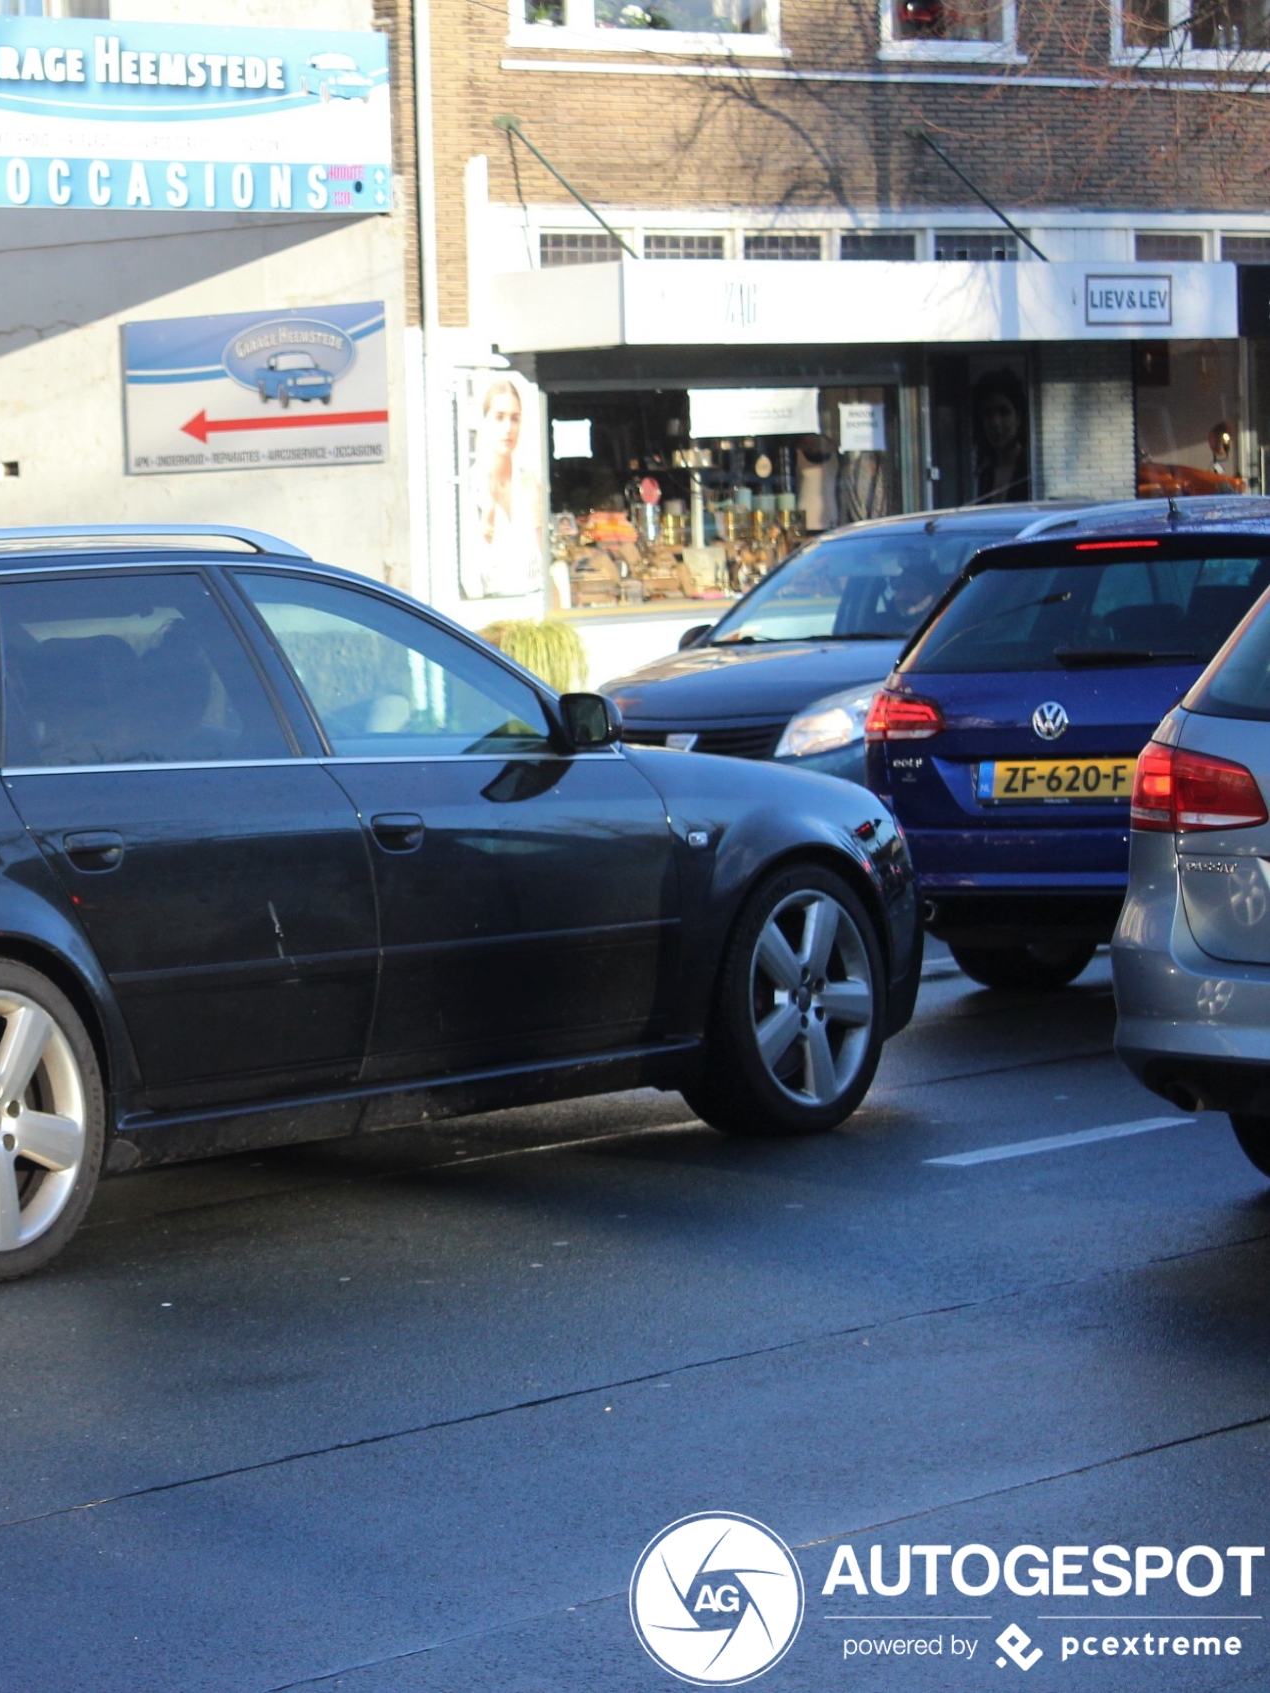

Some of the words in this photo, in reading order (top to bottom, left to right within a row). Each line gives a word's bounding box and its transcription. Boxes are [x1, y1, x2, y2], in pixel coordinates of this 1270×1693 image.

[94, 36, 286, 90] HEEMSTEDE
[5, 158, 328, 210] OCCASIONS
[1003, 766, 1127, 793] ZF-620-F
